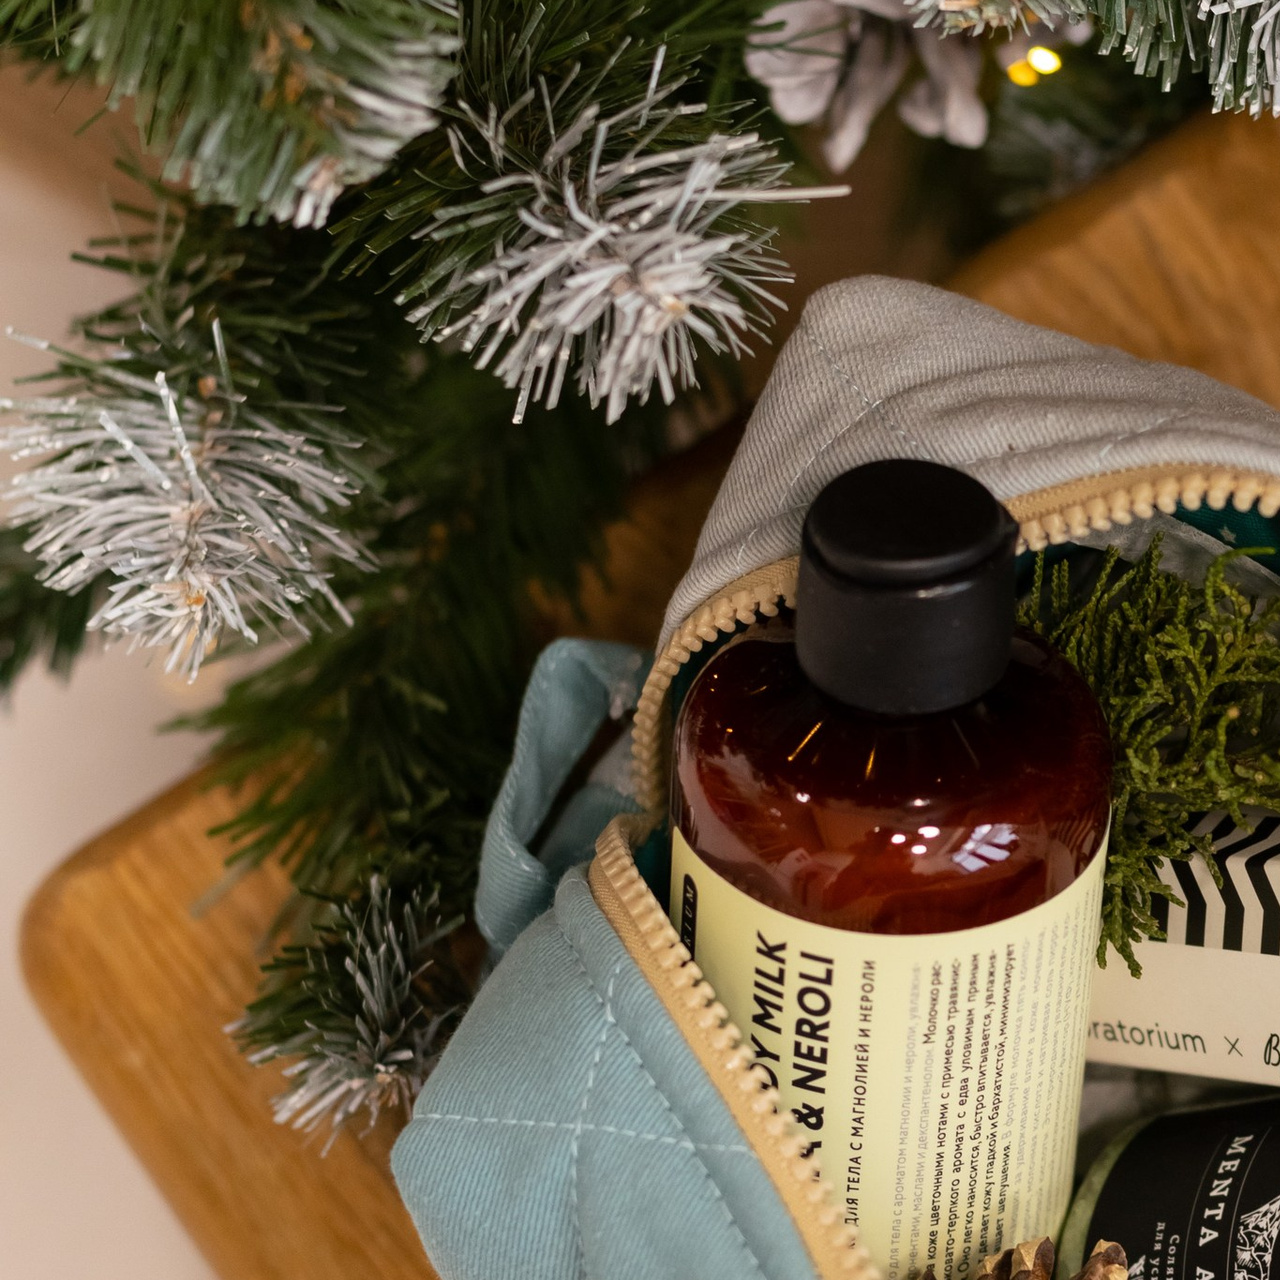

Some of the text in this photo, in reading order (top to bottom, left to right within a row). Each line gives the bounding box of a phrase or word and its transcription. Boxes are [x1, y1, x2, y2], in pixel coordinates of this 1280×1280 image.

[859, 959, 876, 1022] НЕРОЛИ
[930, 961, 943, 986] рас-
[966, 954, 980, 1002] пряным
[999, 943, 1016, 1036] минимизирует
[749, 930, 787, 1114] DY MILK
[791, 950, 834, 1095] NEROLI
[858, 1028, 871, 1039] И
[922, 988, 940, 1044] Молочко
[960, 1008, 975, 1072] уловимым
[941, 1025, 956, 1088] примесью
[976, 1009, 994, 1091] впитывается,
[850, 1043, 871, 1138] МАГНОЛИЕЙ
[958, 1078, 970, 1106] едва
[989, 1037, 1007, 1120] бархатистой,
[790, 1102, 825, 1131] &
[898, 1086, 912, 1145] магнолии
[936, 1103, 949, 1148] нотами
[970, 1095, 986, 1140] быстро
[849, 1142, 863, 1151] С
[951, 1124, 965, 1173] аромата
[985, 1132, 998, 1179] гладкой
[846, 1156, 863, 1192] ТЕЛА
[893, 1148, 906, 1207] ароматом
[913, 1161, 925, 1211] маслами
[929, 1151, 945, 1226] цветочными
[966, 1141, 982, 1208] наносится,
[983, 1182, 995, 1210] кожу
[997, 1141, 1011, 1214] шелушения.
[1198, 1135, 1254, 1247] MENTA
[844, 1197, 860, 1227] ДЛЯ
[890, 1219, 901, 1245] тела
[962, 1211, 974, 1243] легко
[979, 1214, 990, 1254] делает
[889, 1248, 900, 1268] для
[926, 1230, 938, 1260] коже
[957, 1246, 971, 1272] Оно
[1154, 1222, 1166, 1251] для
